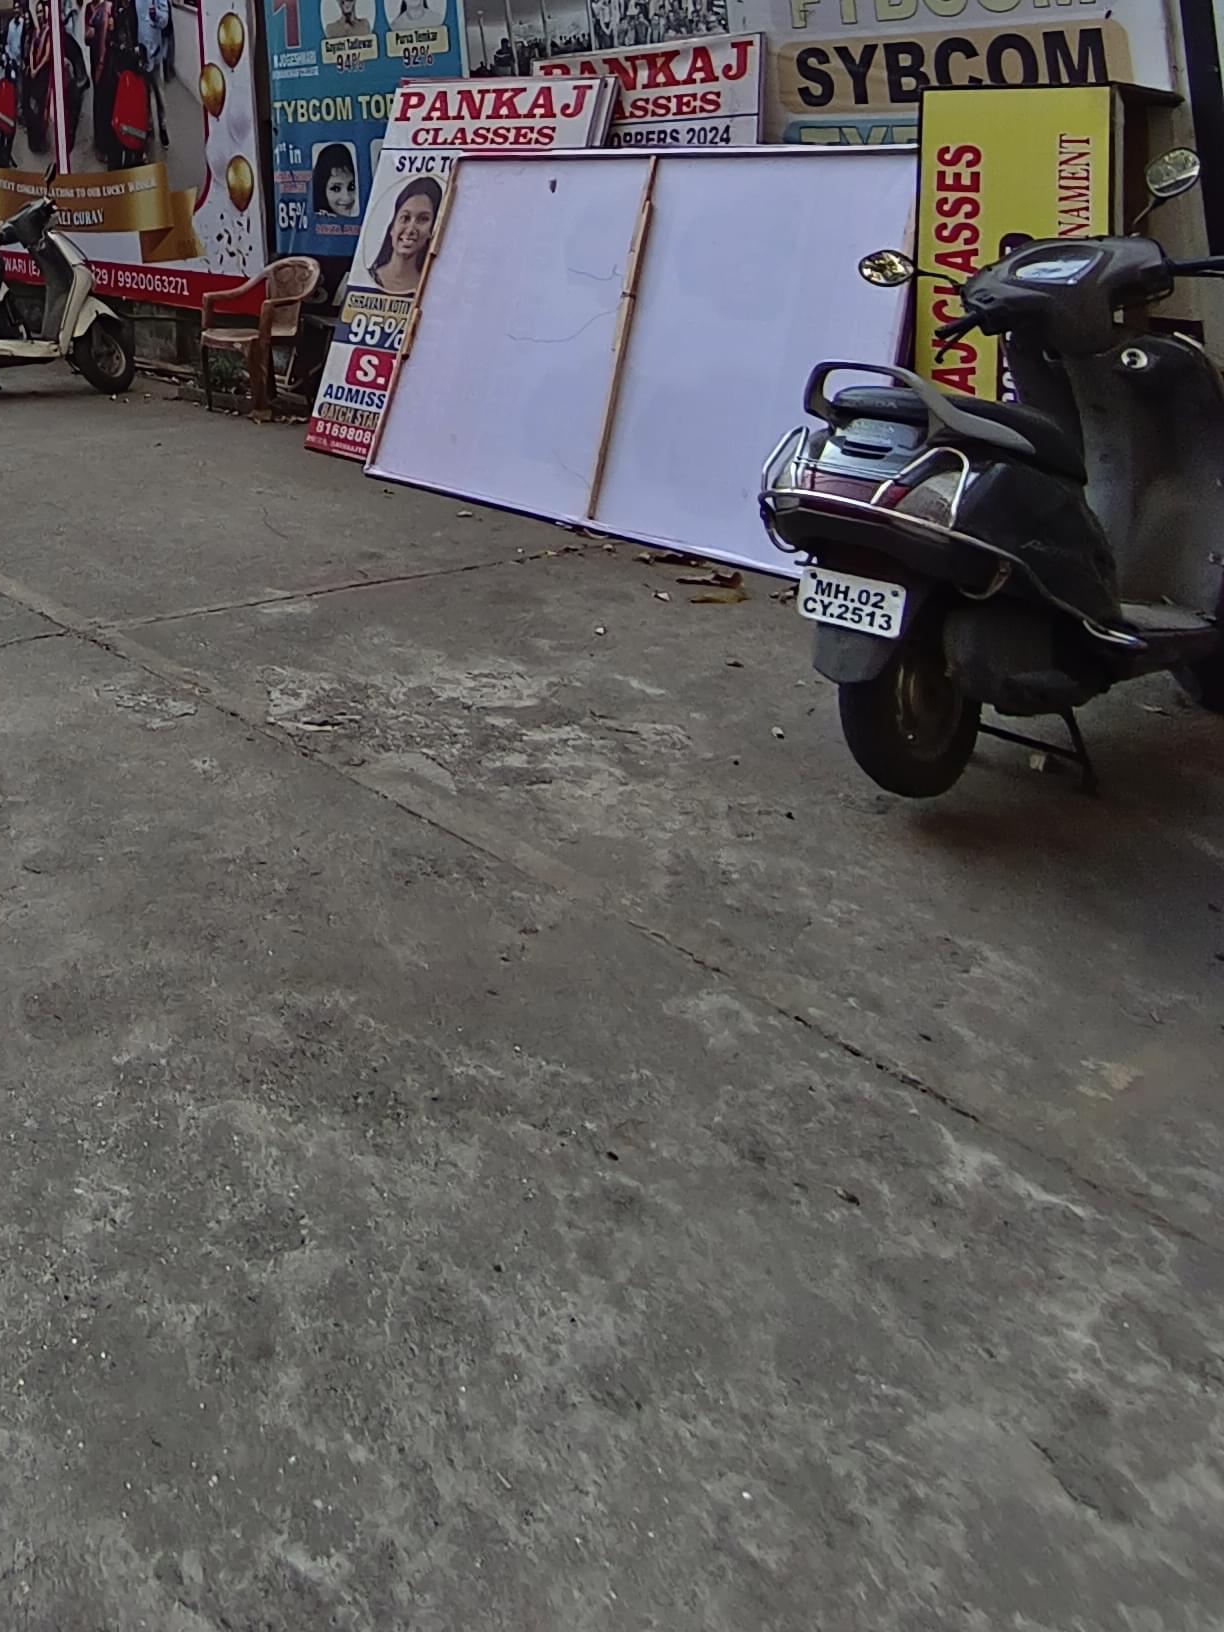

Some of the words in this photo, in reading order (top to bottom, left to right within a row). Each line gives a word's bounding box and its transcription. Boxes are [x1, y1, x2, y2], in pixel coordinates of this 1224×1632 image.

[337, 53, 364, 72] 94%
[403, 45, 433, 66] 92%
[795, 27, 1108, 107] SYBCOM
[273, 96, 353, 125] TYBCOM
[394, 84, 593, 122] PANKAJ
[411, 126, 557, 146] CLASSES
[686, 125, 731, 145] 2024
[289, 144, 302, 164] in
[396, 156, 436, 173] SYJC
[76, 188, 85, 198] TO
[87, 187, 101, 198] OUR
[102, 183, 126, 197] LUCKY
[279, 201, 308, 229] 85%
[118, 271, 190, 296] 9920063271
[348, 314, 407, 349] 95%
[324, 384, 387, 409] ADMISS
[814, 580, 886, 610] MH.02
[803, 597, 893, 631] CY.2513
